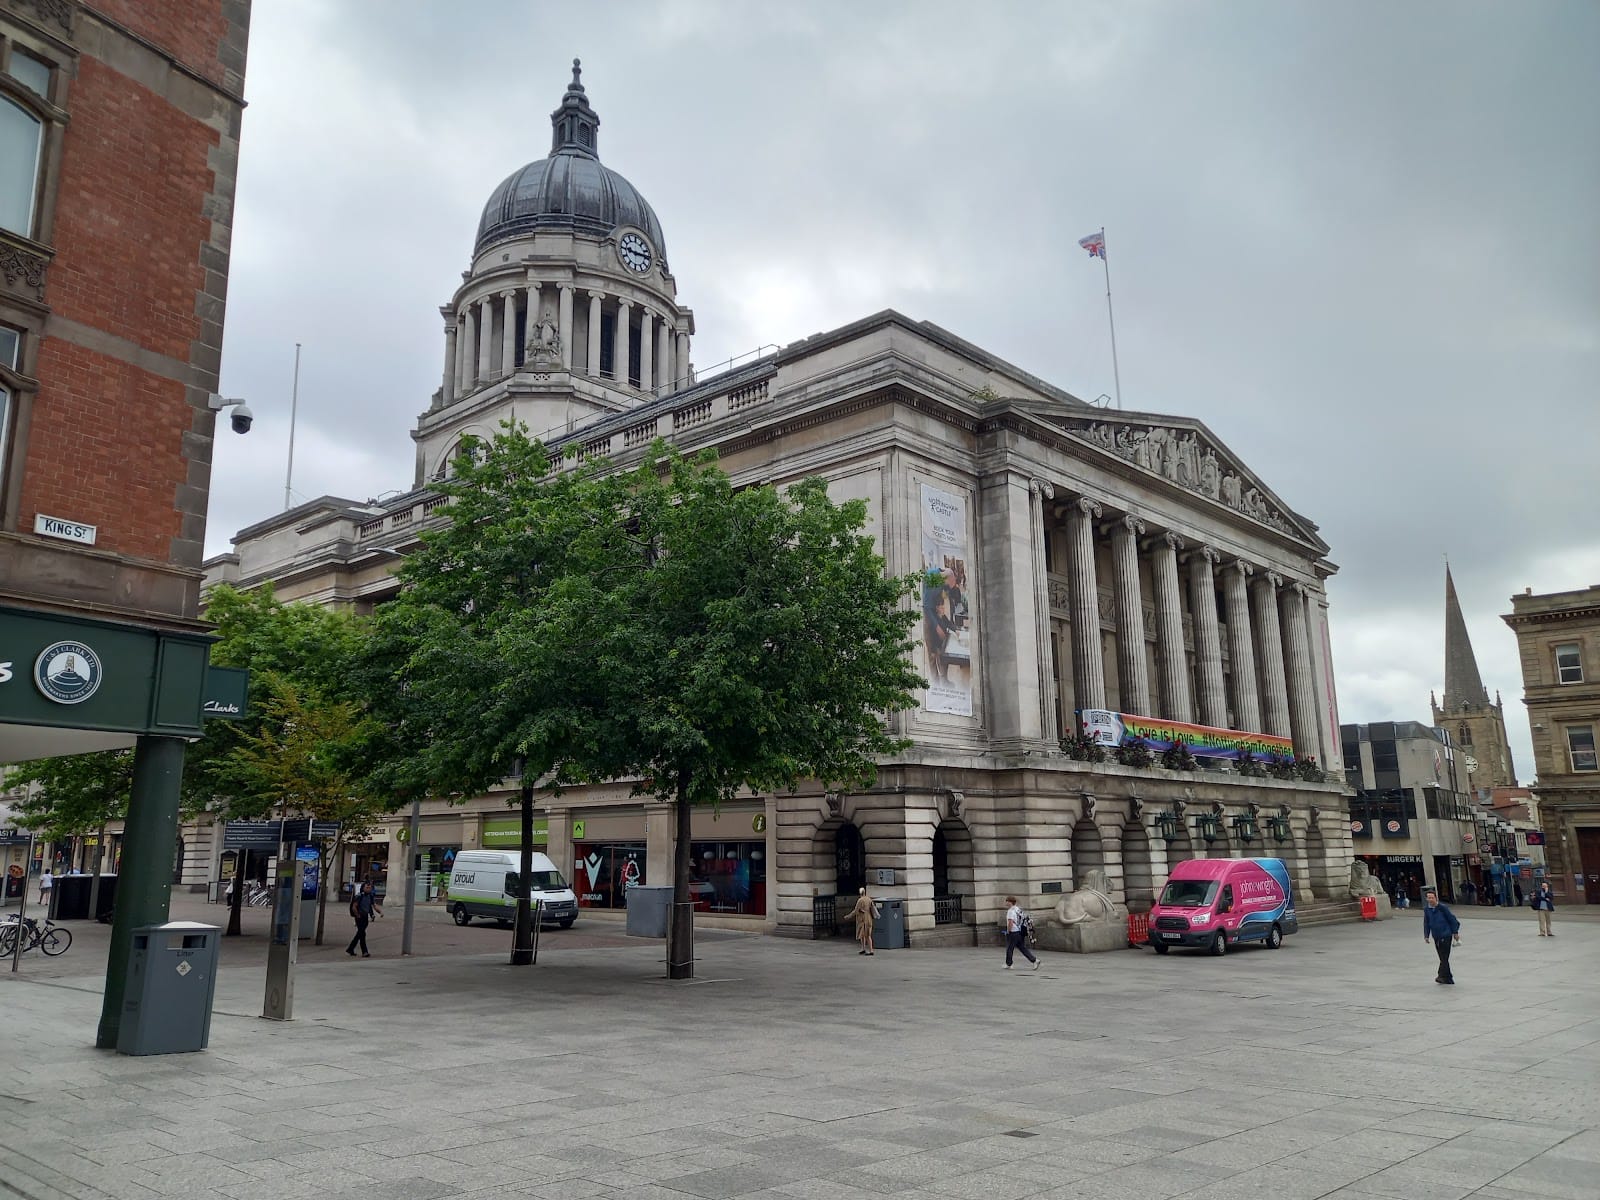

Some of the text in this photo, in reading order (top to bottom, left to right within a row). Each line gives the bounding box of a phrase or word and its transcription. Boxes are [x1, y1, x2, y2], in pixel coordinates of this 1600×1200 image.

[45, 519, 72, 536] KING
[203, 700, 239, 713] Clarks
[1132, 721, 1158, 741] Love
[1160, 726, 1169, 742] is
[1172, 728, 1195, 745] Love
[454, 872, 476, 886] proud
